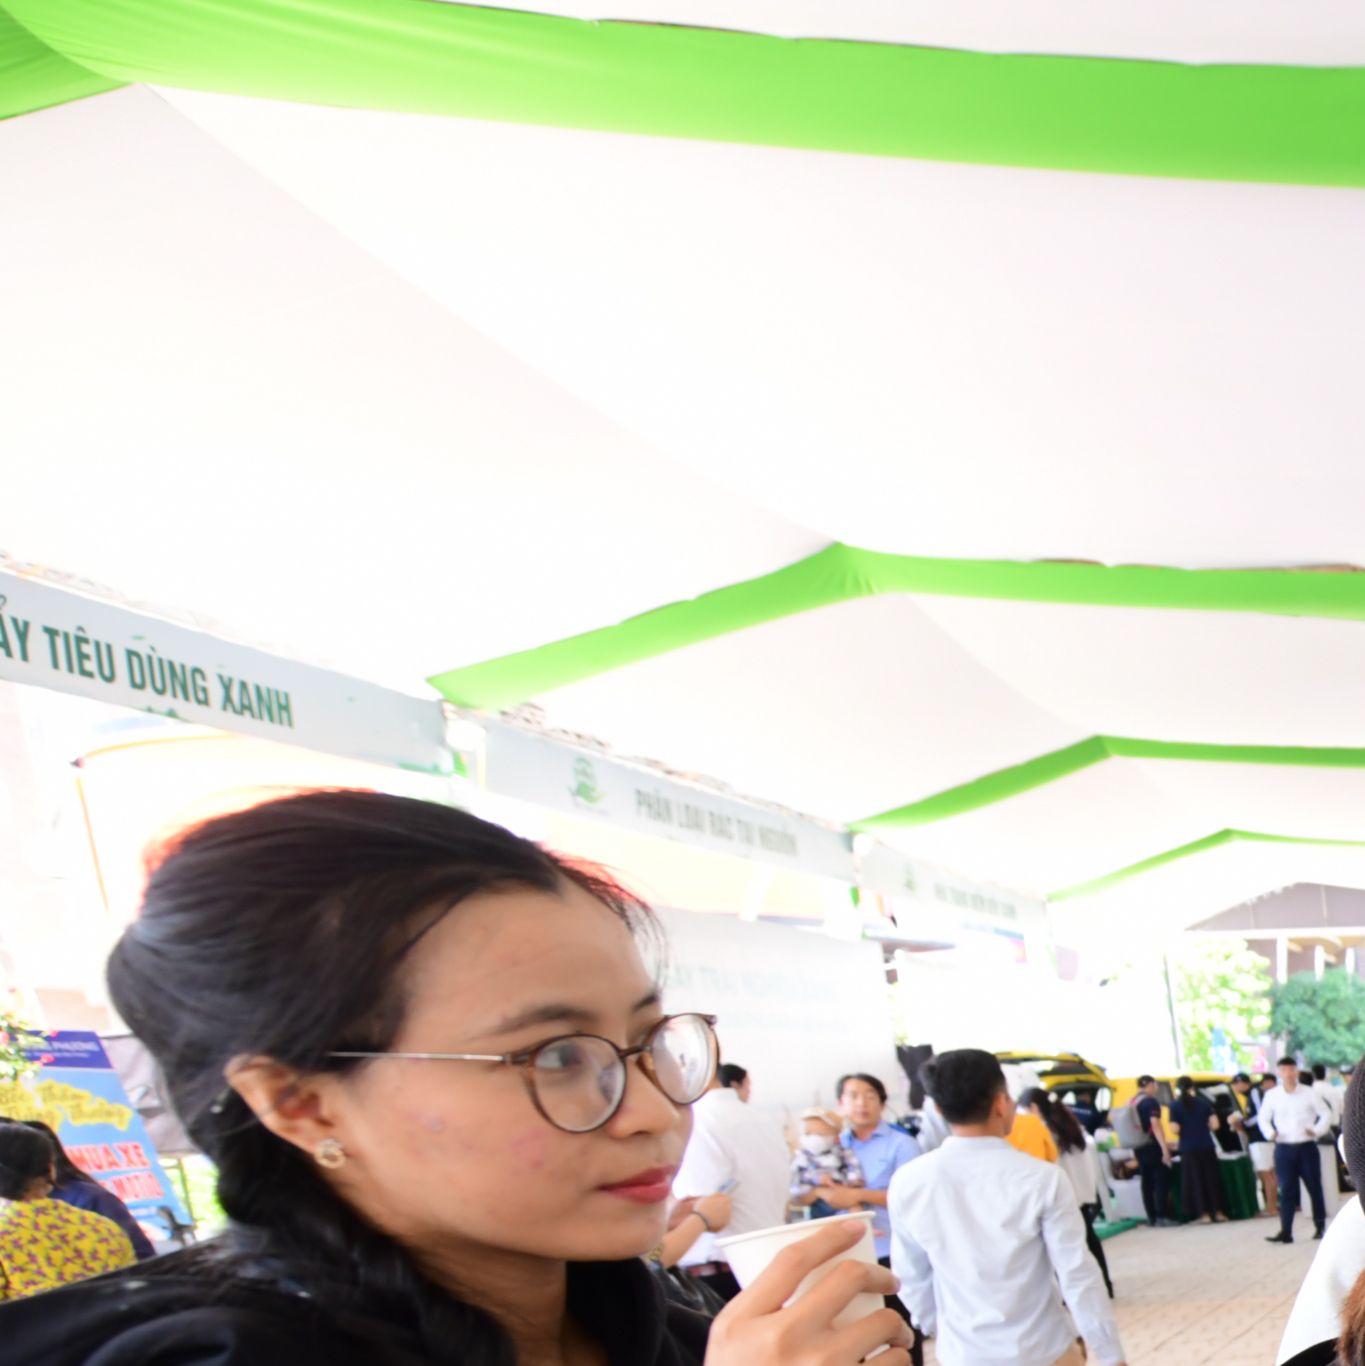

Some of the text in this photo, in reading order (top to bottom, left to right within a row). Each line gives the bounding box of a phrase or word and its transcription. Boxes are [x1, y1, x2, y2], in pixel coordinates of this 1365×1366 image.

[42, 625, 116, 683] TIÊU
[125, 645, 210, 706] DÙNG
[216, 673, 294, 729] XANH
